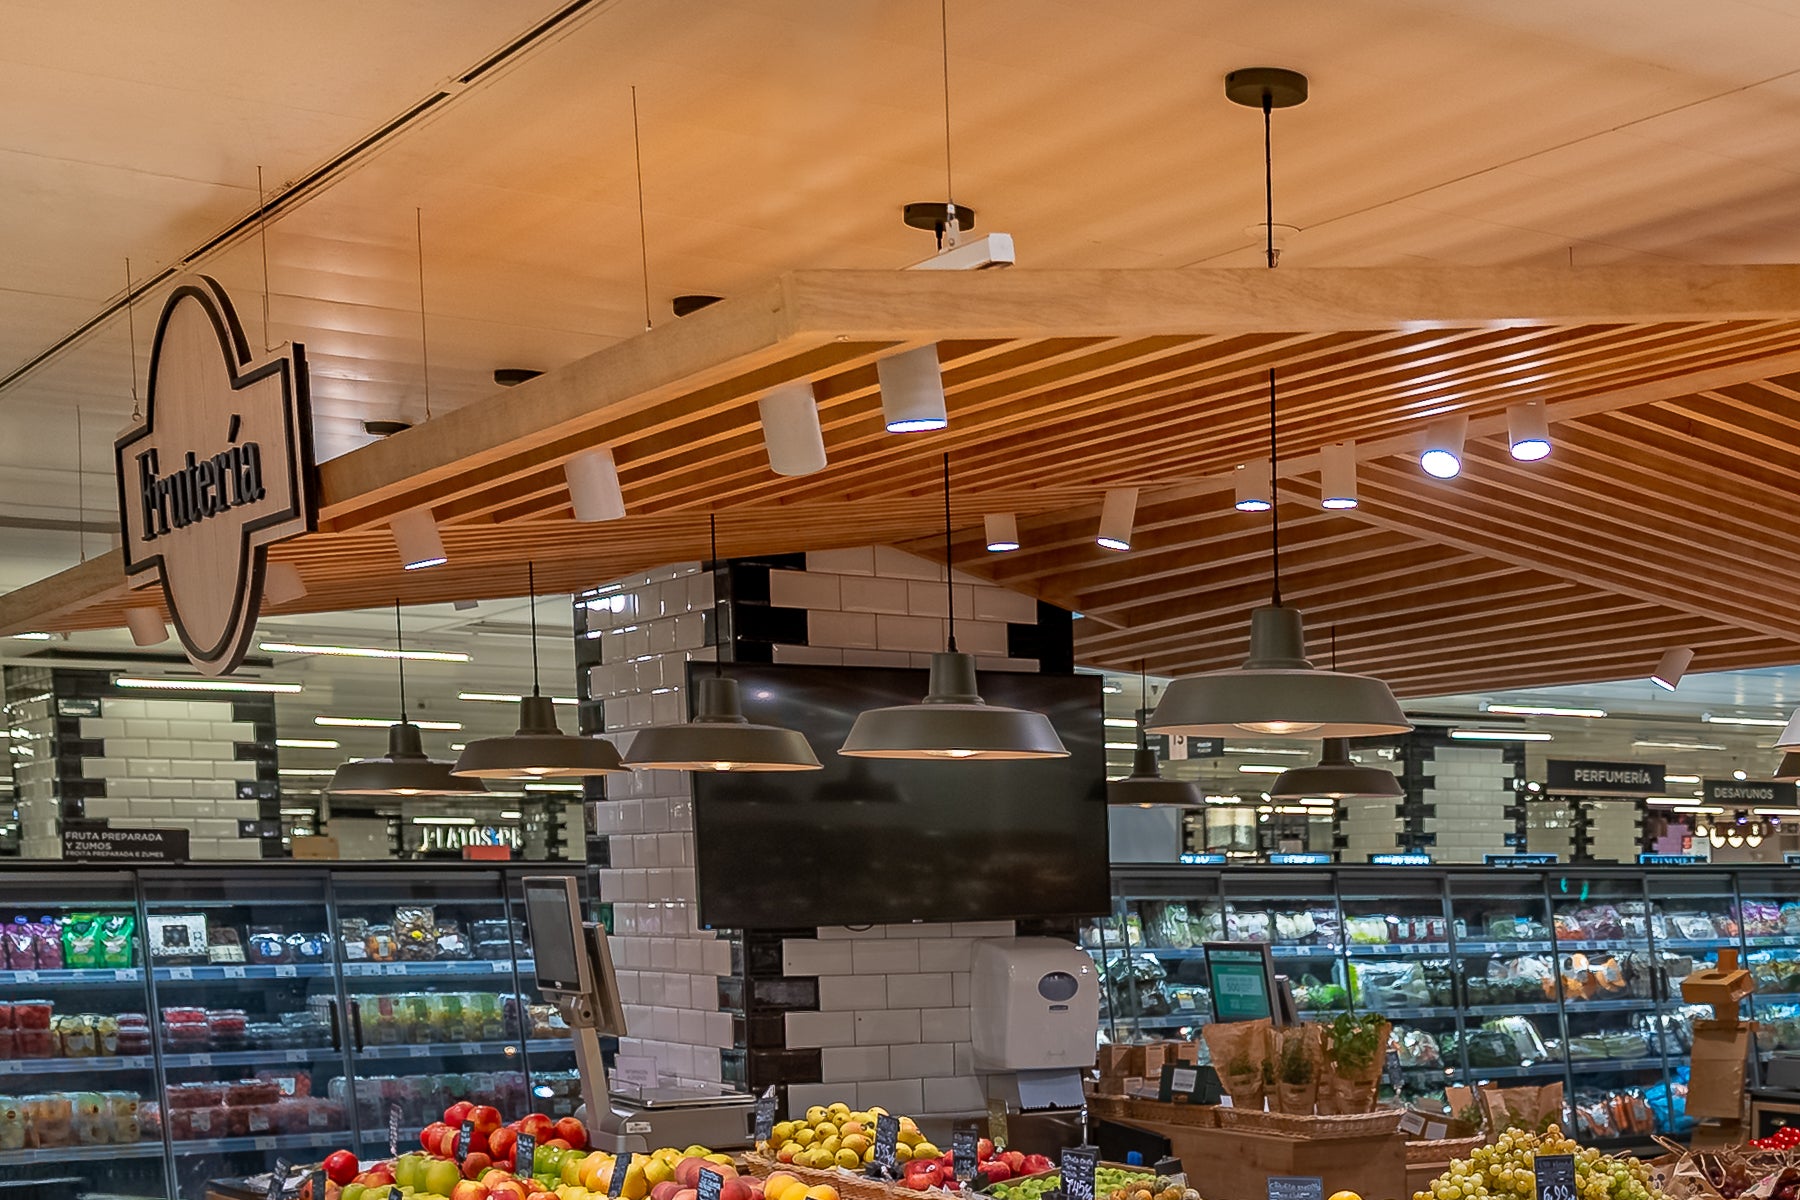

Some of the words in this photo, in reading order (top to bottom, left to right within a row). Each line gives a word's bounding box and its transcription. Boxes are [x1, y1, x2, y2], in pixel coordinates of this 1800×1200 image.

[136, 413, 265, 541] Frutería
[1574, 768, 1651, 784] PERFUMERÍA
[1714, 787, 1774, 800] DESAYUNOS
[65, 831, 100, 841] FRUTA
[101, 832, 163, 842] PREPARADA
[65, 842, 72, 850] Y
[75, 842, 112, 851] ZUMOS
